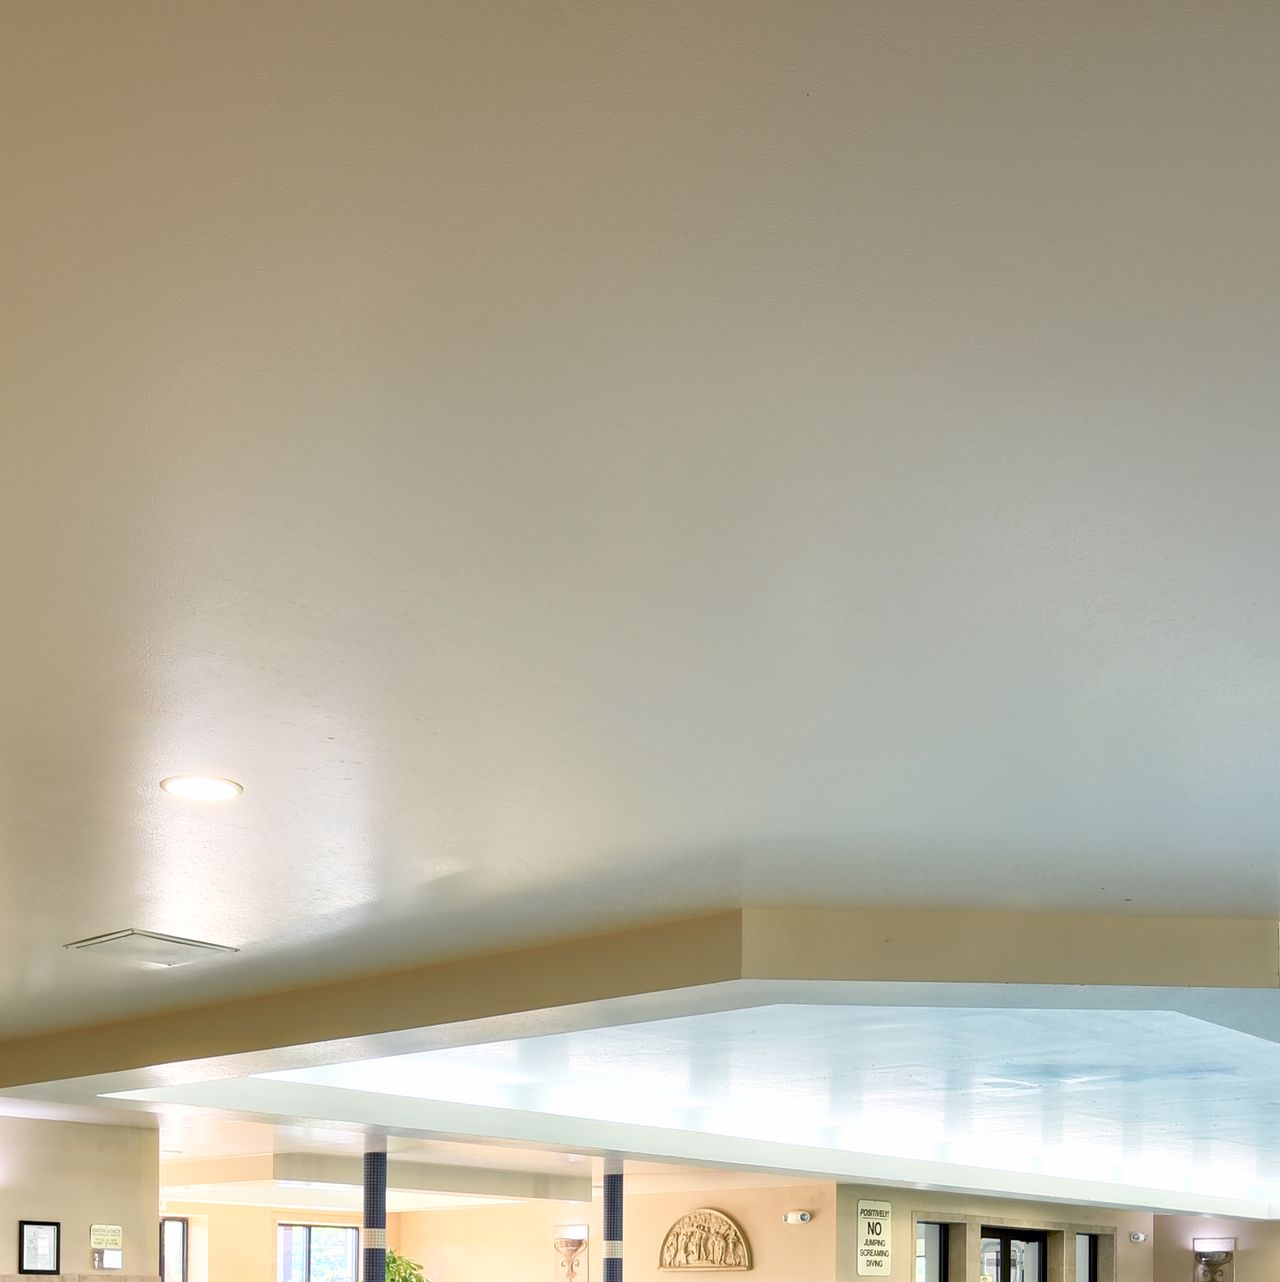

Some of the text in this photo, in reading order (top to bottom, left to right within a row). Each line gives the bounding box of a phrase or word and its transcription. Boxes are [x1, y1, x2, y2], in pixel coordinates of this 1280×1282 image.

[867, 1221, 882, 1236] NO
[864, 1239, 885, 1247] JUMPING
[860, 1249, 889, 1257] SCREAMING
[866, 1259, 883, 1267] DIVING
